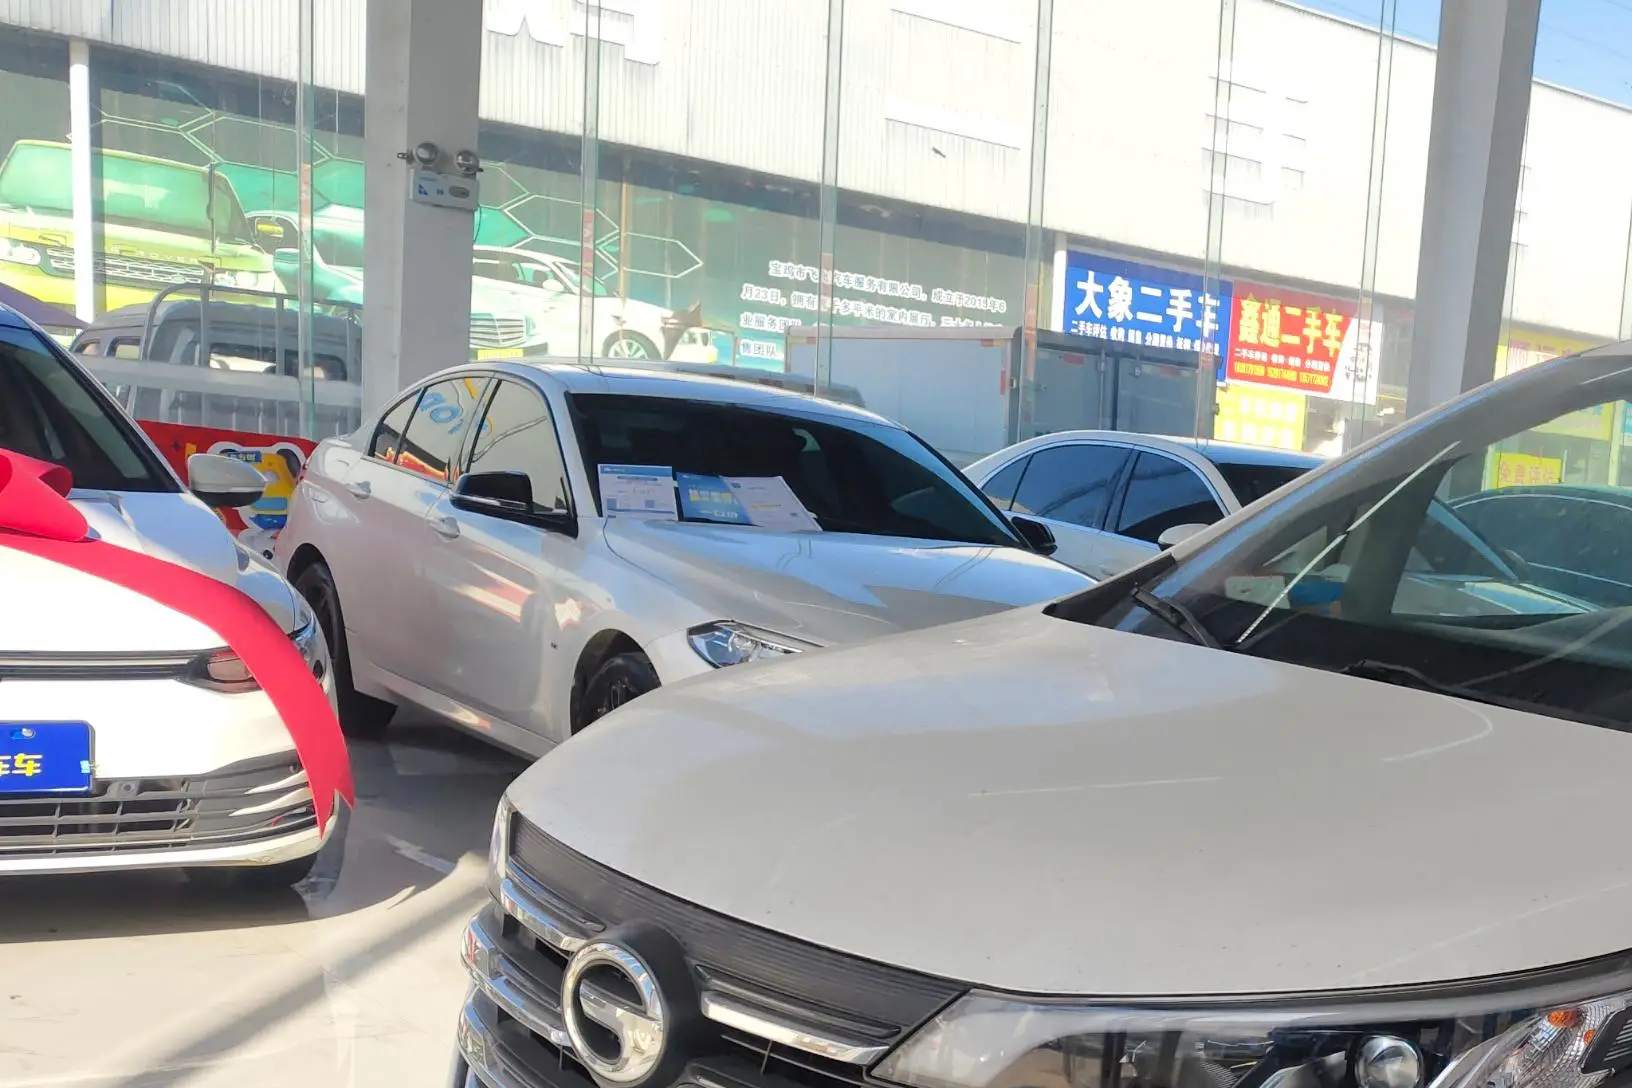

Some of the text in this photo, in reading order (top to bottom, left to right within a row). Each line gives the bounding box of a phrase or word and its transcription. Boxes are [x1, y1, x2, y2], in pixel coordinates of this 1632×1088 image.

[1075, 270, 1220, 337] 大象二手车
[1239, 292, 1343, 357] 鑫通二手车
